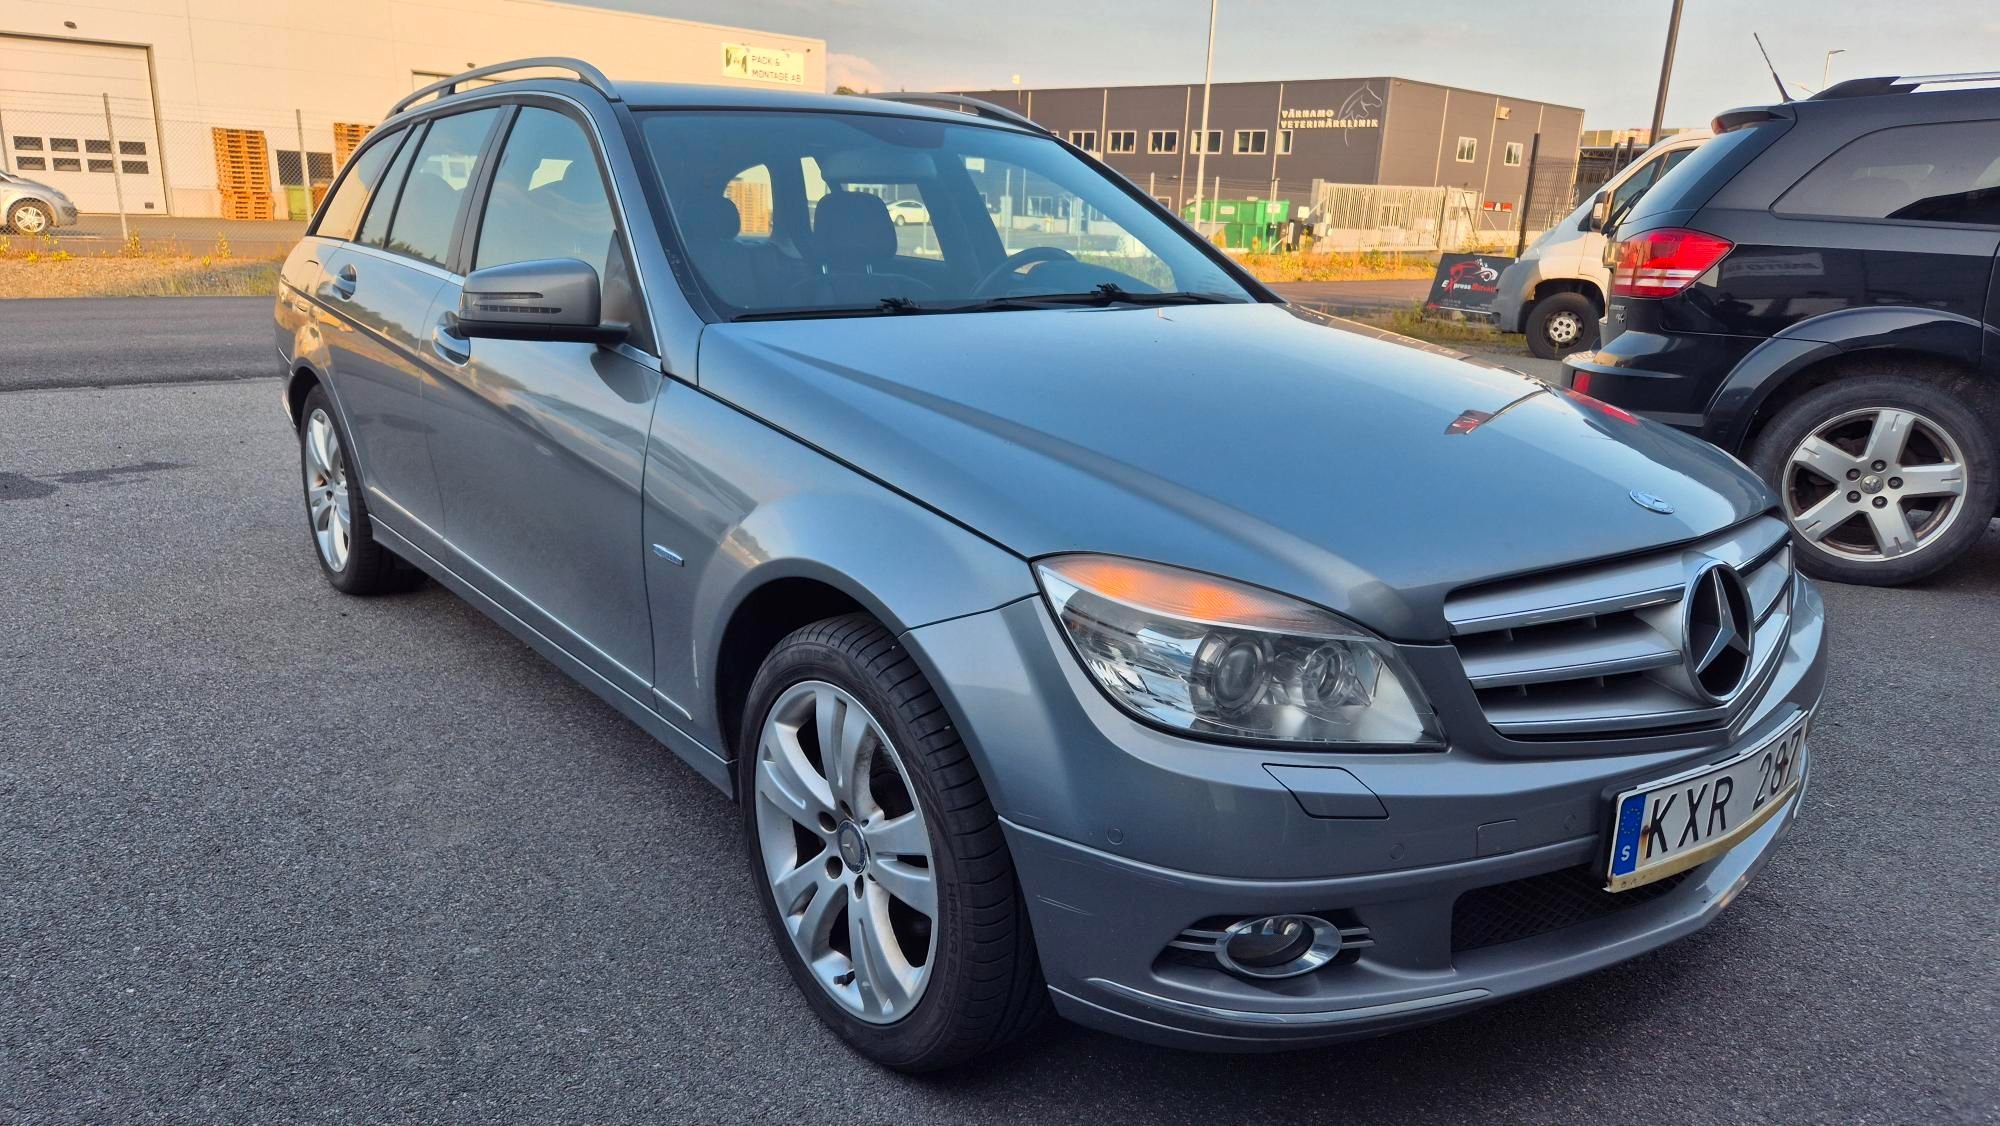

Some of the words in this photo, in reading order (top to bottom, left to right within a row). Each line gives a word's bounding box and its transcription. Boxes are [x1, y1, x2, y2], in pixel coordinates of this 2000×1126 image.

[752, 55, 772, 65] PACK
[752, 69, 789, 81] MONTAGE
[1281, 109, 1334, 118] VÄRNAMO
[1281, 118, 1378, 128] VETERINÄRKLINIK
[1645, 775, 1734, 859] KXR
[1752, 726, 1803, 811] 287
[1620, 844, 1632, 862] S
